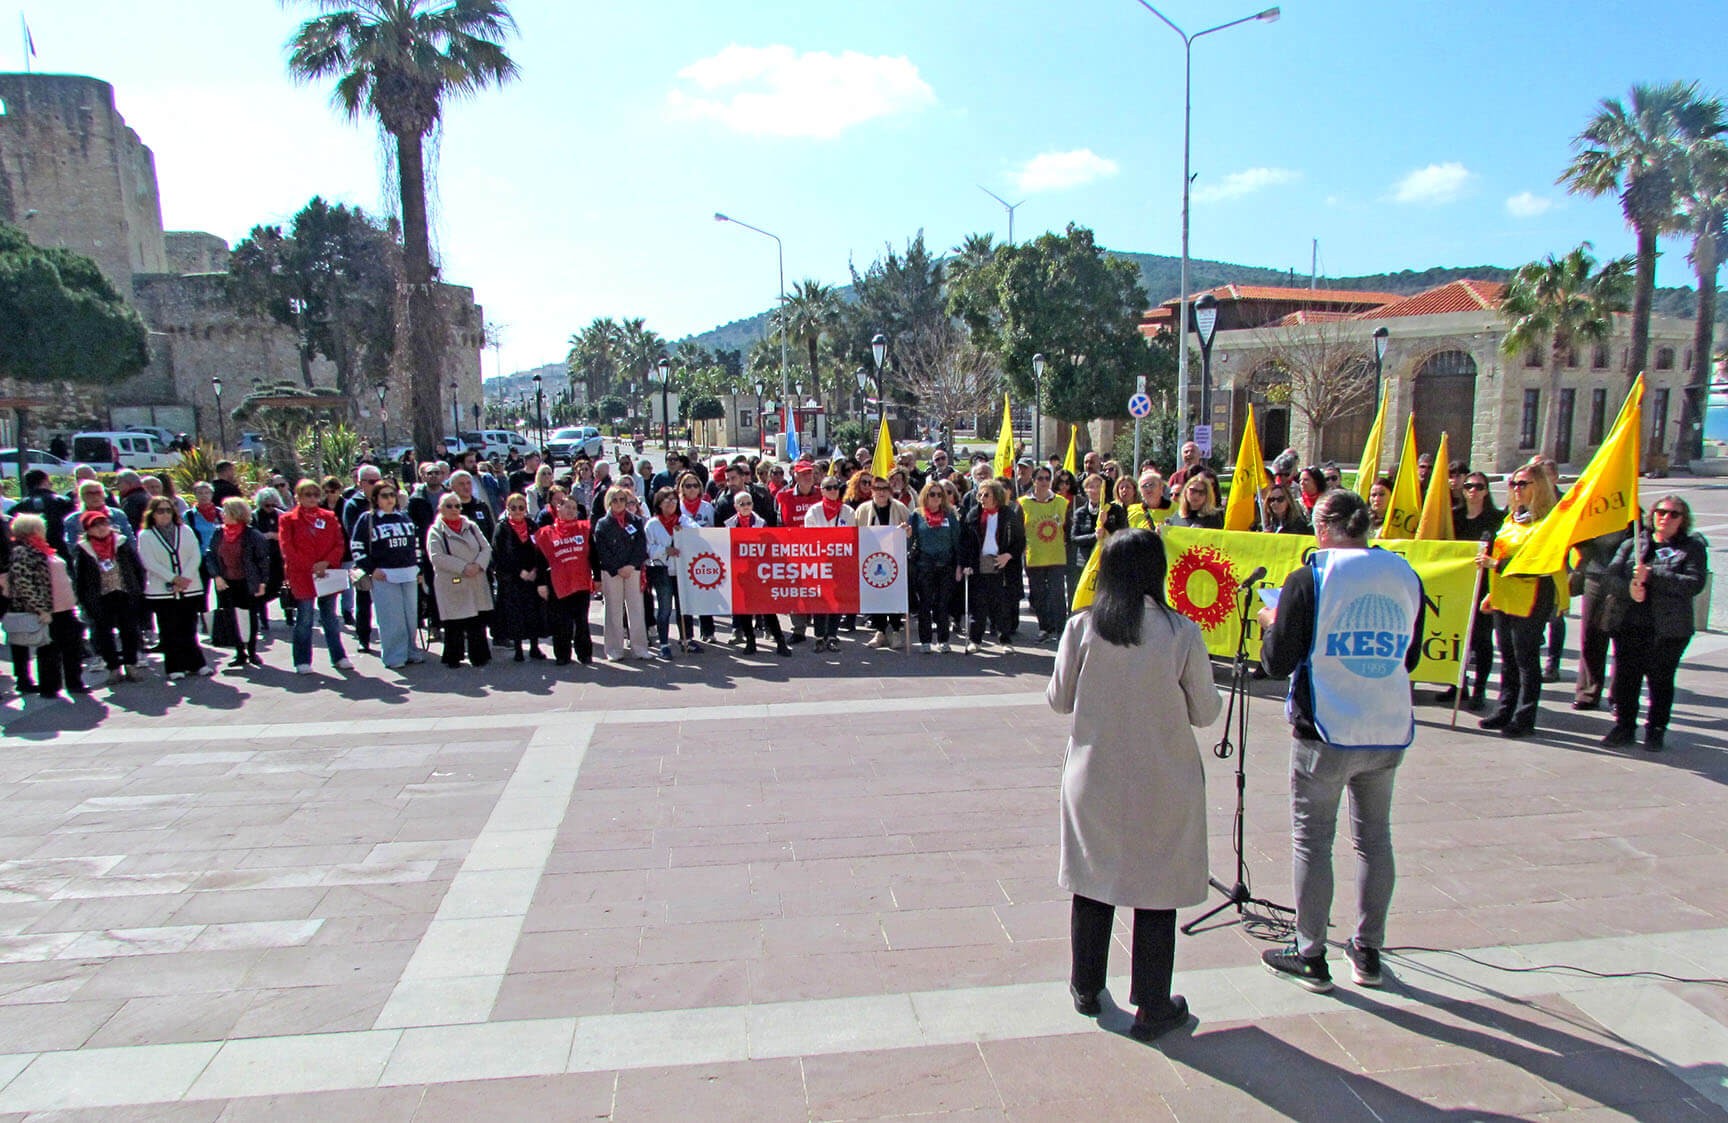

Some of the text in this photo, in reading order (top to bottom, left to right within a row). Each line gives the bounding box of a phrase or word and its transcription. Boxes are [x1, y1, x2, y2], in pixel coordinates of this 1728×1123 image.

[388, 537, 408, 548] 1970
[739, 540, 853, 557] DEV EMEKLİ-SEN
[757, 562, 833, 584] ÇEŞME
[771, 584, 822, 600] ŞUBESİ
